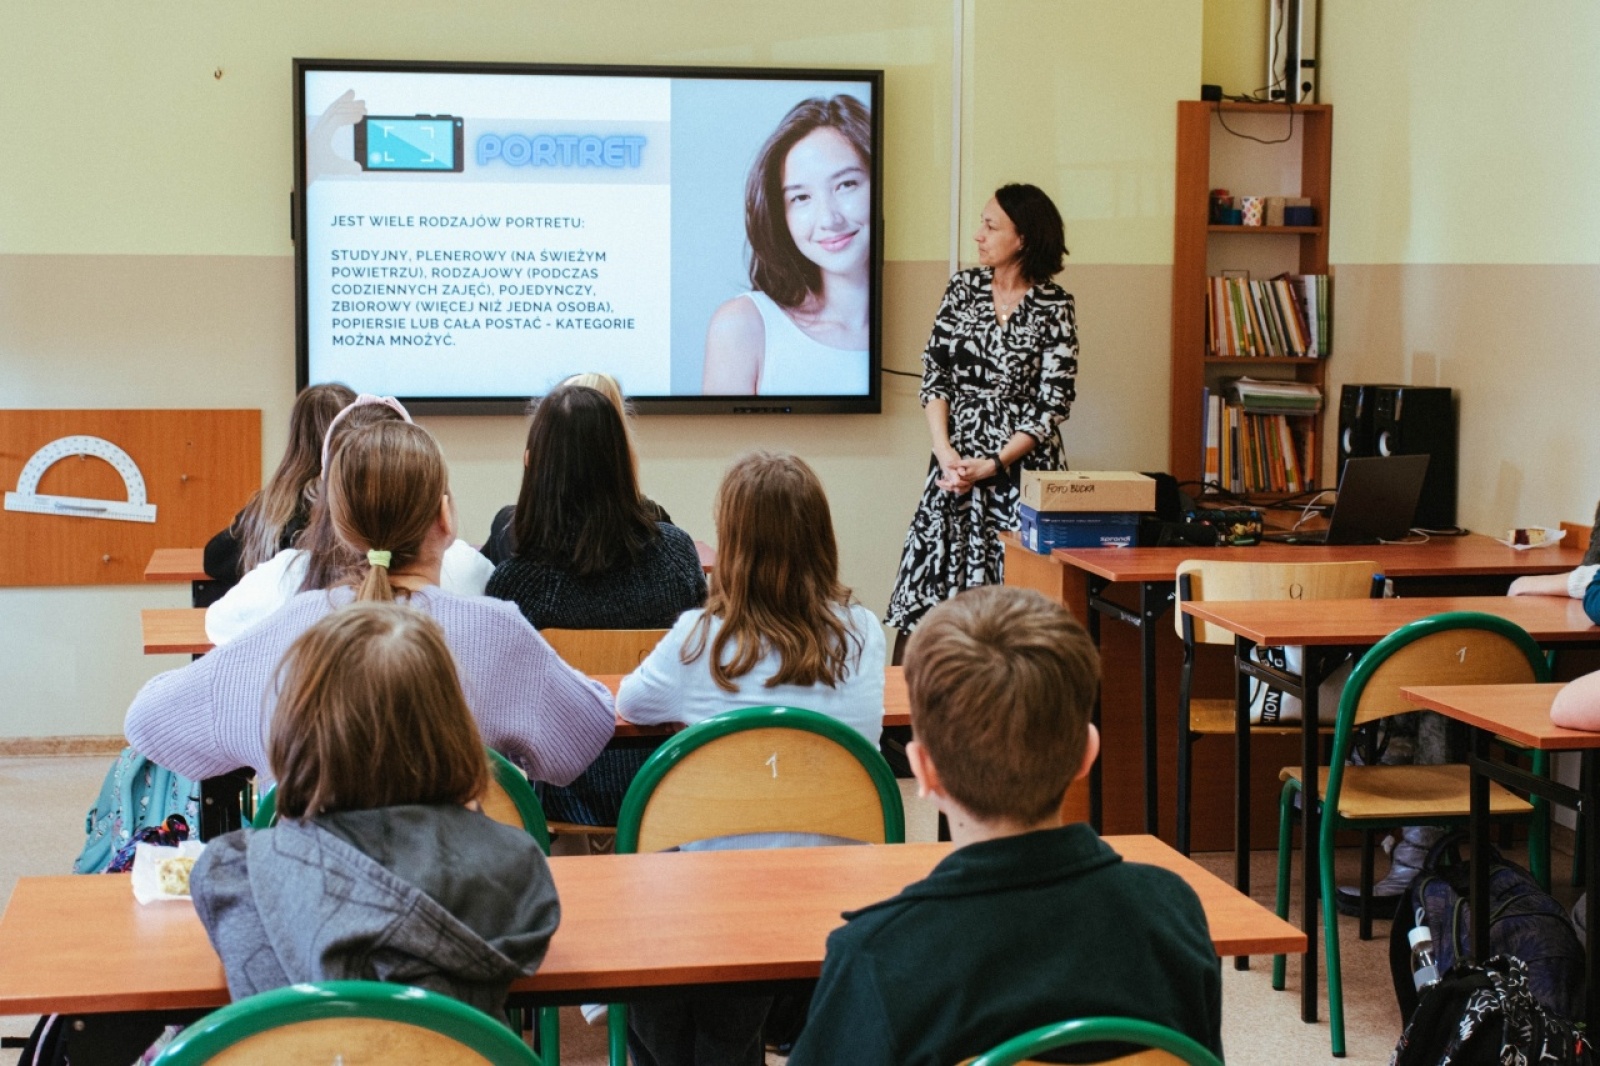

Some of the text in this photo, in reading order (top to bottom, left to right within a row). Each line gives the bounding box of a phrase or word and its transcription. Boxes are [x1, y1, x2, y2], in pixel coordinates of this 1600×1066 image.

[478, 134, 646, 167] PORTRET
[330, 214, 585, 229] JEST WIELE RODZAJÓW PORTRETU:
[331, 248, 606, 262] STUDYJNY, PLENEROWY (NA ŚWIEŻYM
[331, 266, 599, 280] POWIETRZU), RODZAJOWY (PODCZAS
[331, 282, 596, 298] CODZIENNYCH ZAJĘĆ), POJEDYNCZY,
[331, 299, 614, 314] ZBIOROWY (WIĘCEJ NIŻ JEDNA OSOBA),
[331, 317, 406, 330] POPIERSIE
[410, 318, 440, 330] LUB
[443, 318, 481, 330] CAŁA
[485, 316, 542, 330] POSTAĆ
[555, 317, 635, 330] KATEGORIE
[332, 333, 456, 347] MOŻNA MNOŻYĆ.
[1455, 646, 1467, 663] 1
[765, 752, 778, 779] 1
